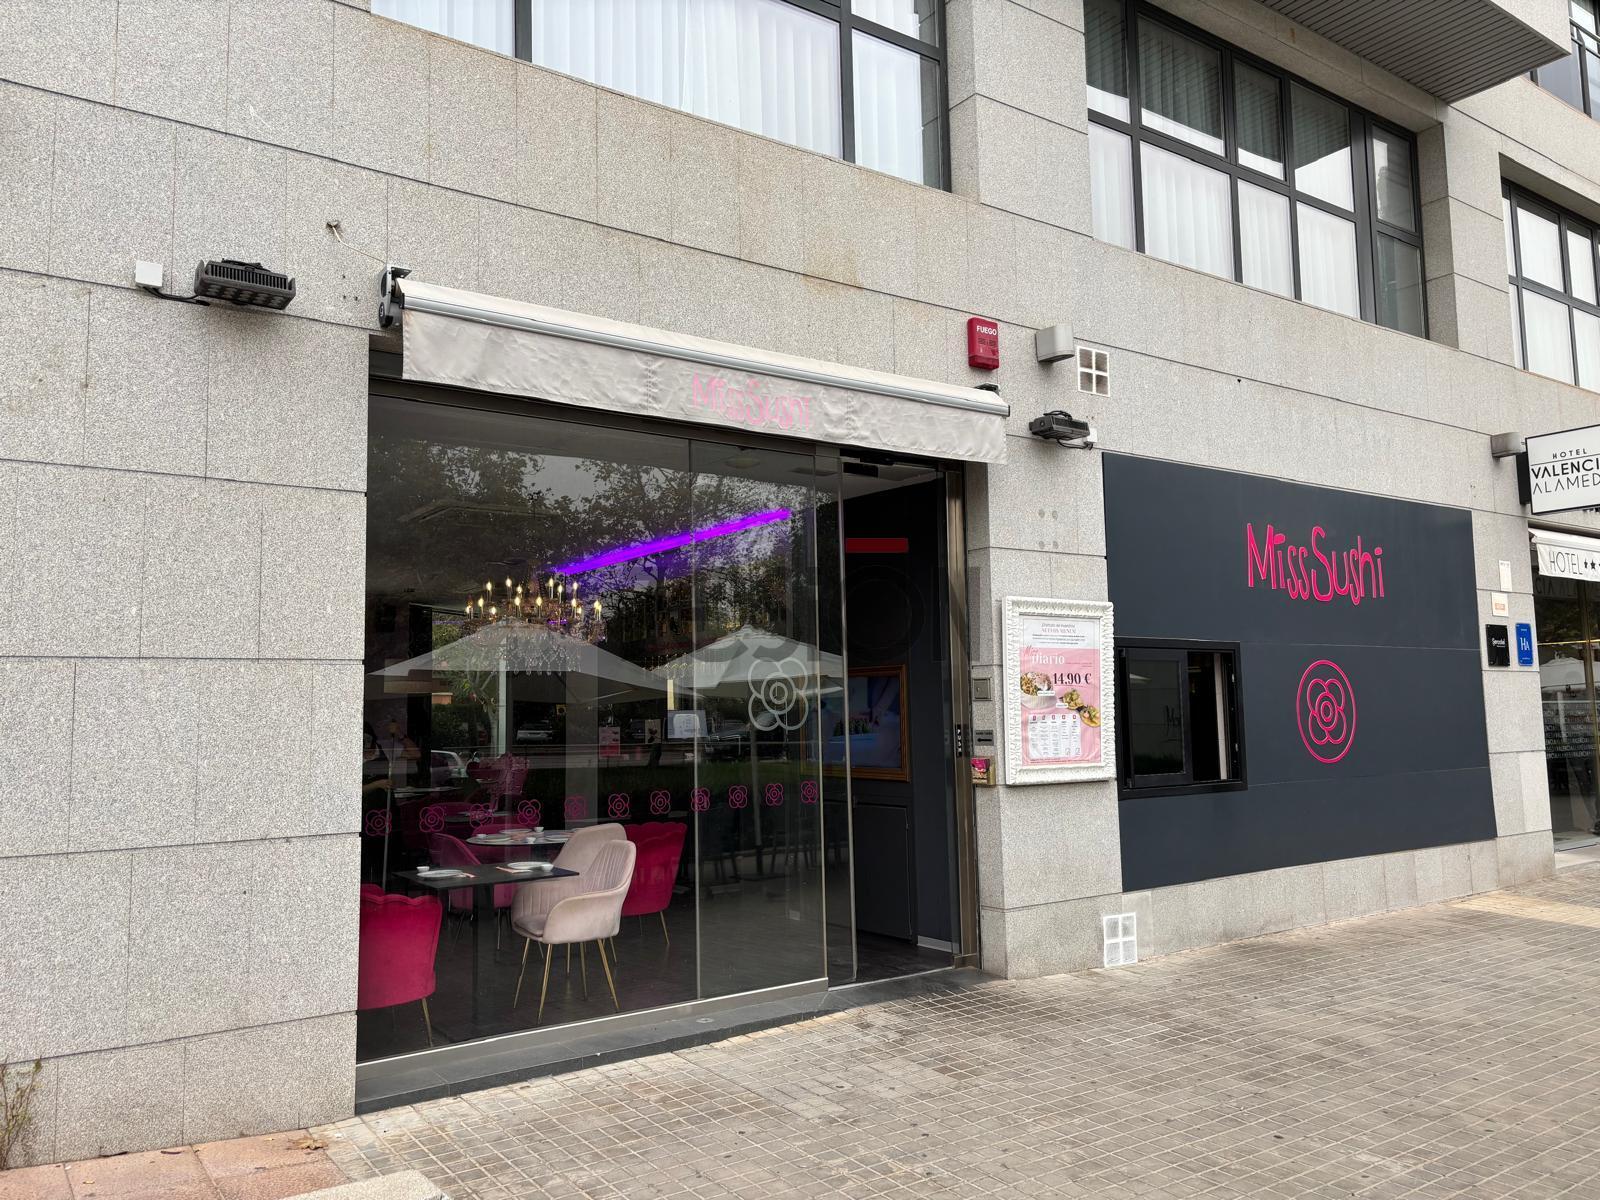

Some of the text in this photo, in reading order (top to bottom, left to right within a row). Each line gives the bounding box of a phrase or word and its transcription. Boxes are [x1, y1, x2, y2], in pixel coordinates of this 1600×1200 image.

[976, 325, 997, 336] FUEGO
[1552, 448, 1587, 459] HOTEL
[1531, 457, 1600, 479] VALENCI
[1549, 551, 1583, 575] HOTEL
[1053, 672, 1081, 686] 14.90
